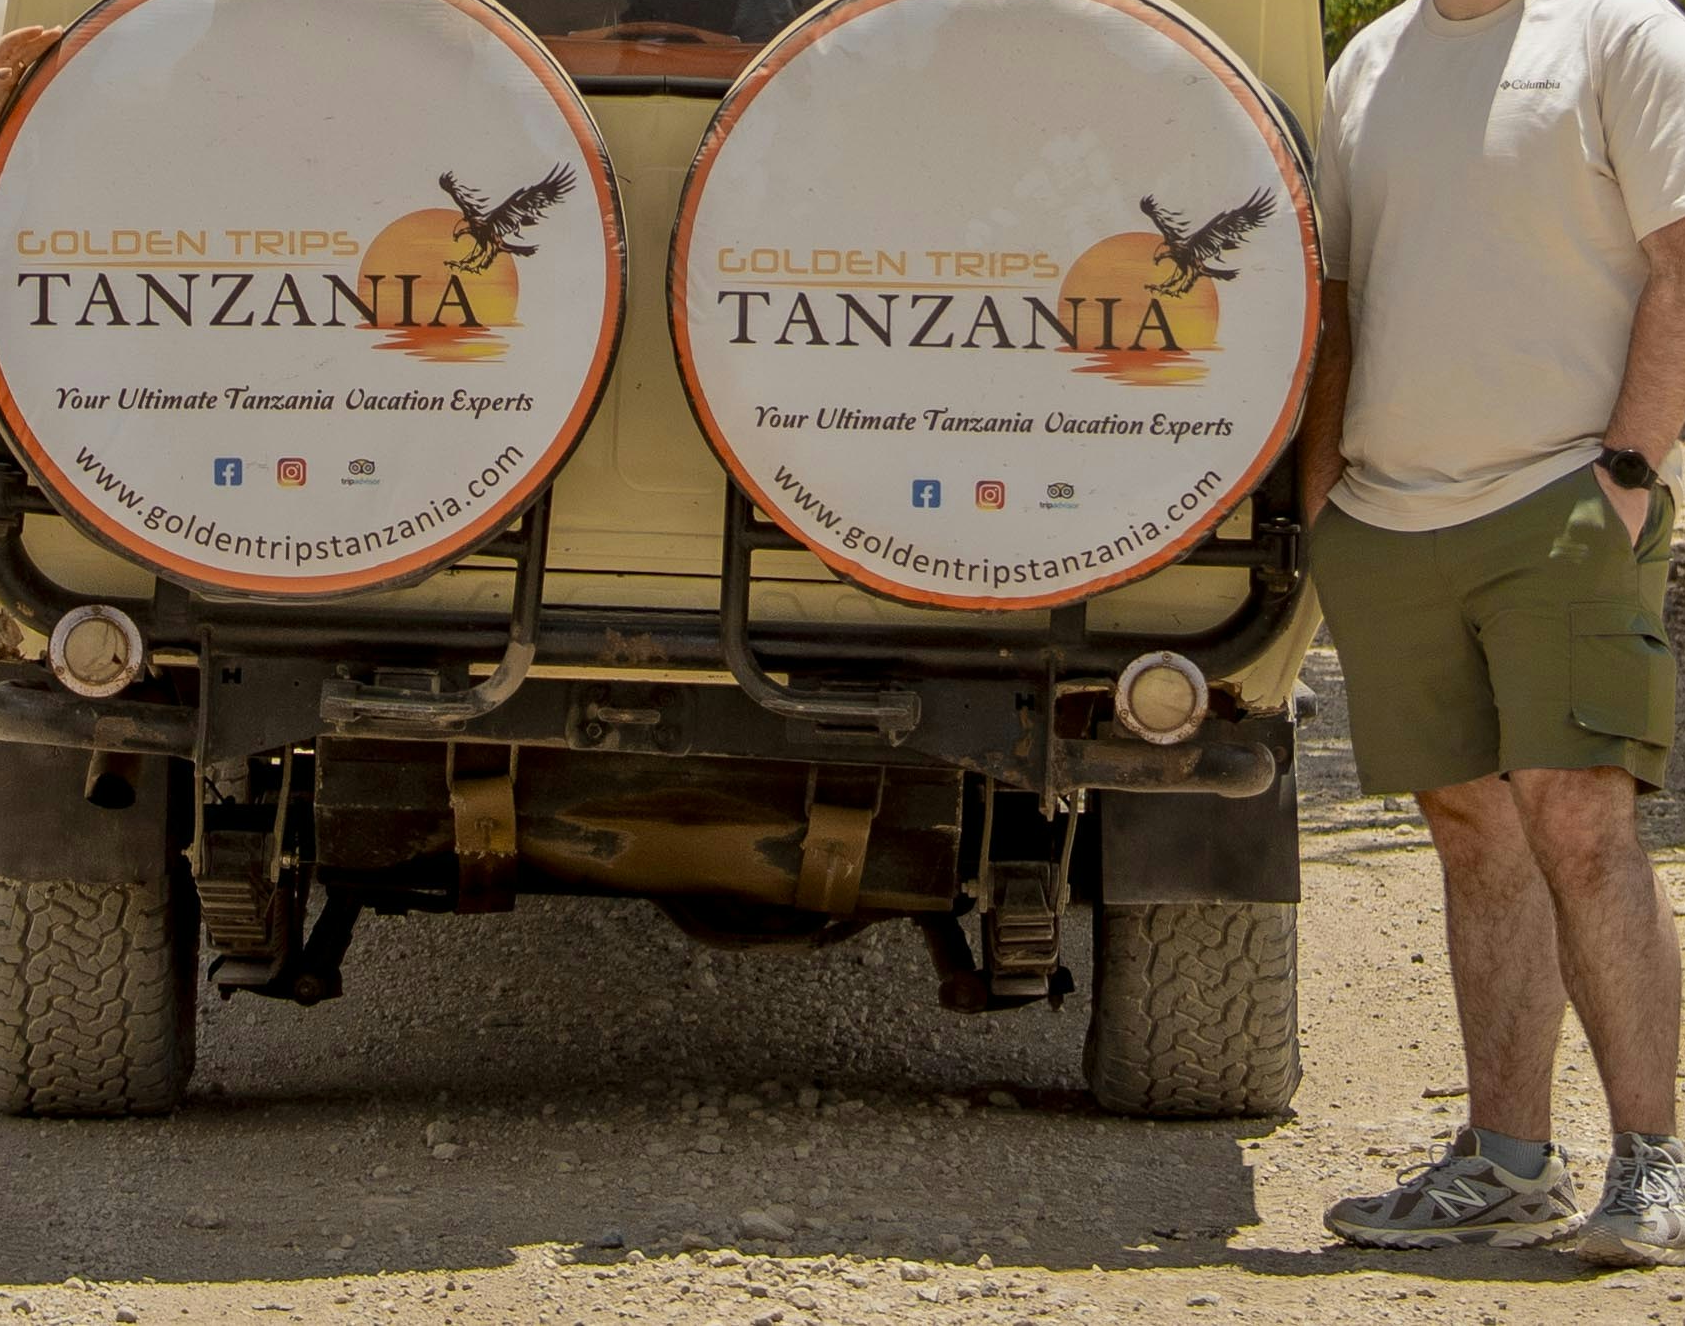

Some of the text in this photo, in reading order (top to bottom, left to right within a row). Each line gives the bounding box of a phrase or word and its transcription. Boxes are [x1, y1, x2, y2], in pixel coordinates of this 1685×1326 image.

[1511, 78, 1561, 90] Columbia
[17, 229, 361, 257] GOLDEN TRIPS
[717, 247, 1061, 279] GOLDEN TRIPS
[17, 272, 491, 328] TANZANIA
[716, 290, 1191, 351] TANZANIA
[55, 386, 534, 419] Your Ultimate Tanzania Vacation Experts
[754, 405, 1234, 444] Your Ultimate Tanzania Vacation Experts
[75, 443, 525, 567] www.goldentripstanzania.com
[773, 464, 1222, 587] www.goldentripstanzania.com
